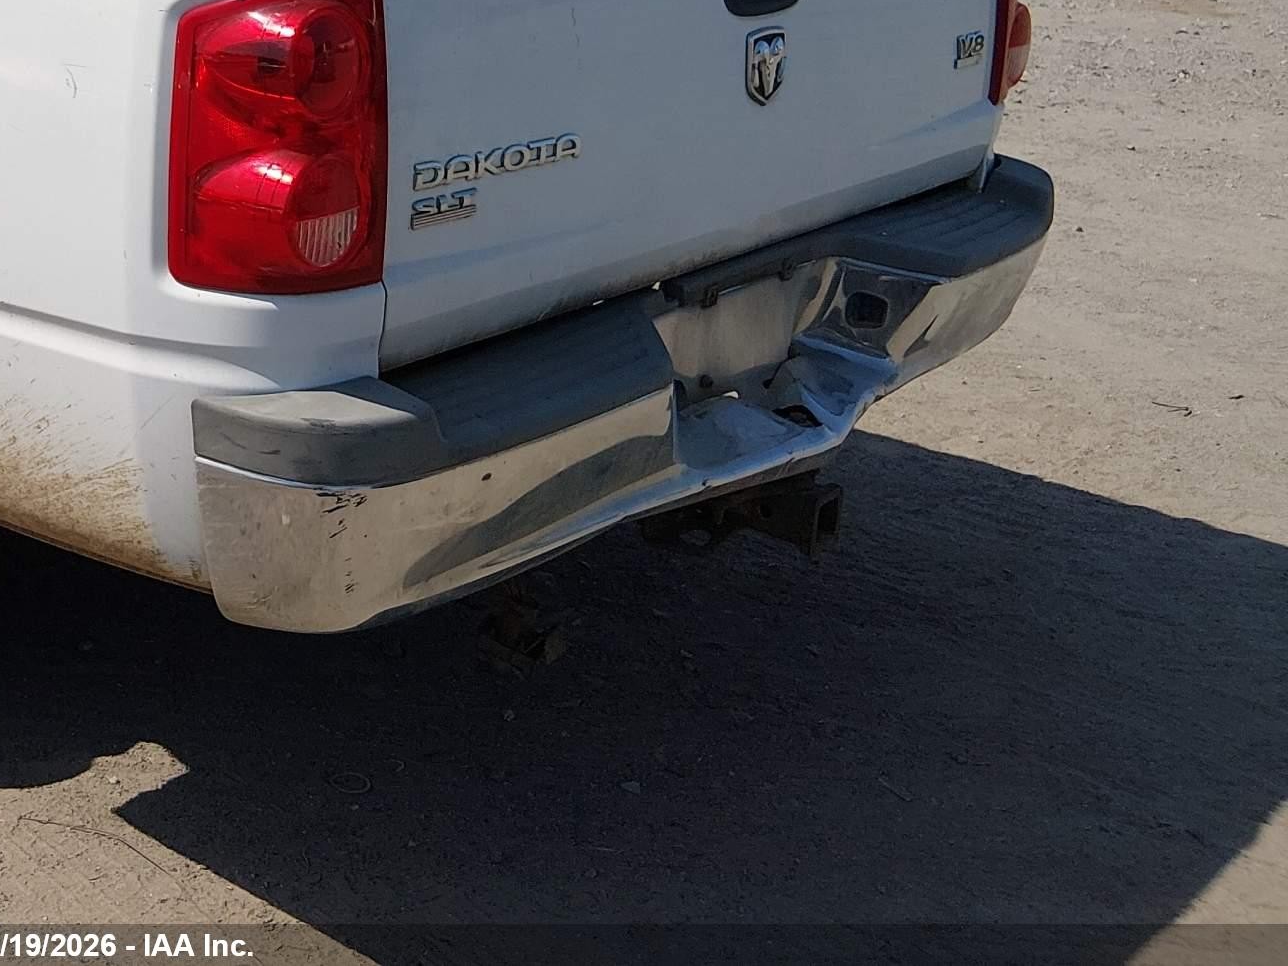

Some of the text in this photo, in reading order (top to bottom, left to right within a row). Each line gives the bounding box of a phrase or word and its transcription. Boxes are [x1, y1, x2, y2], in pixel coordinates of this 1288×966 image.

[956, 31, 985, 60] V8
[413, 132, 582, 192] DAKOTA
[412, 187, 477, 215] SLT
